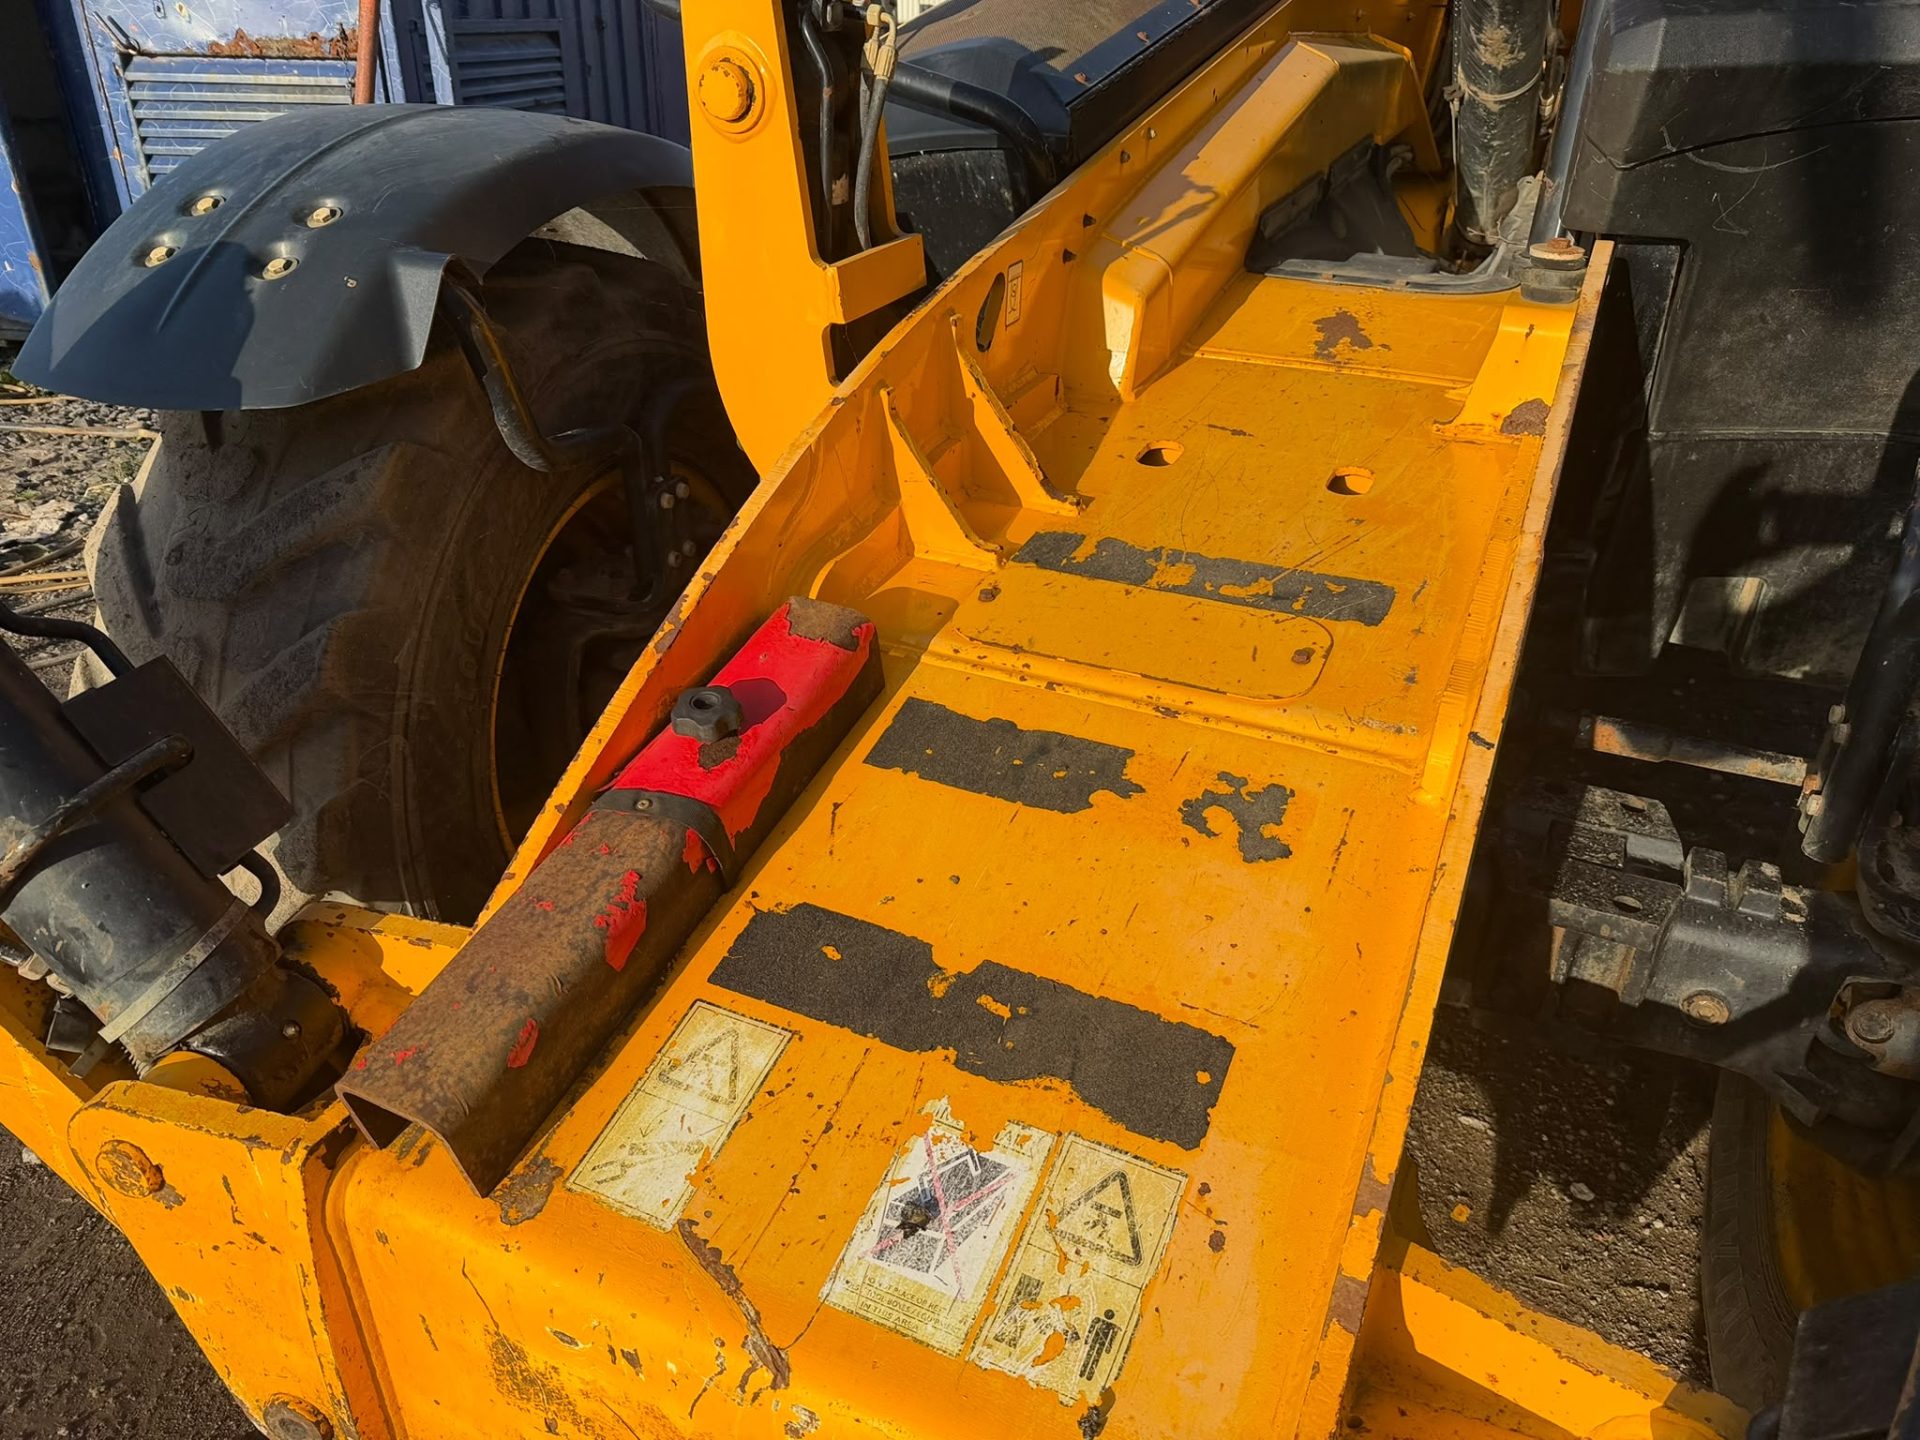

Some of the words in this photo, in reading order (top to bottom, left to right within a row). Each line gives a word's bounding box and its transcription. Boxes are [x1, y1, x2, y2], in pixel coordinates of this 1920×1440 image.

[860, 1301, 872, 1310] IN
[872, 1305, 894, 1320] THIS
[894, 1315, 920, 1331] AREA
